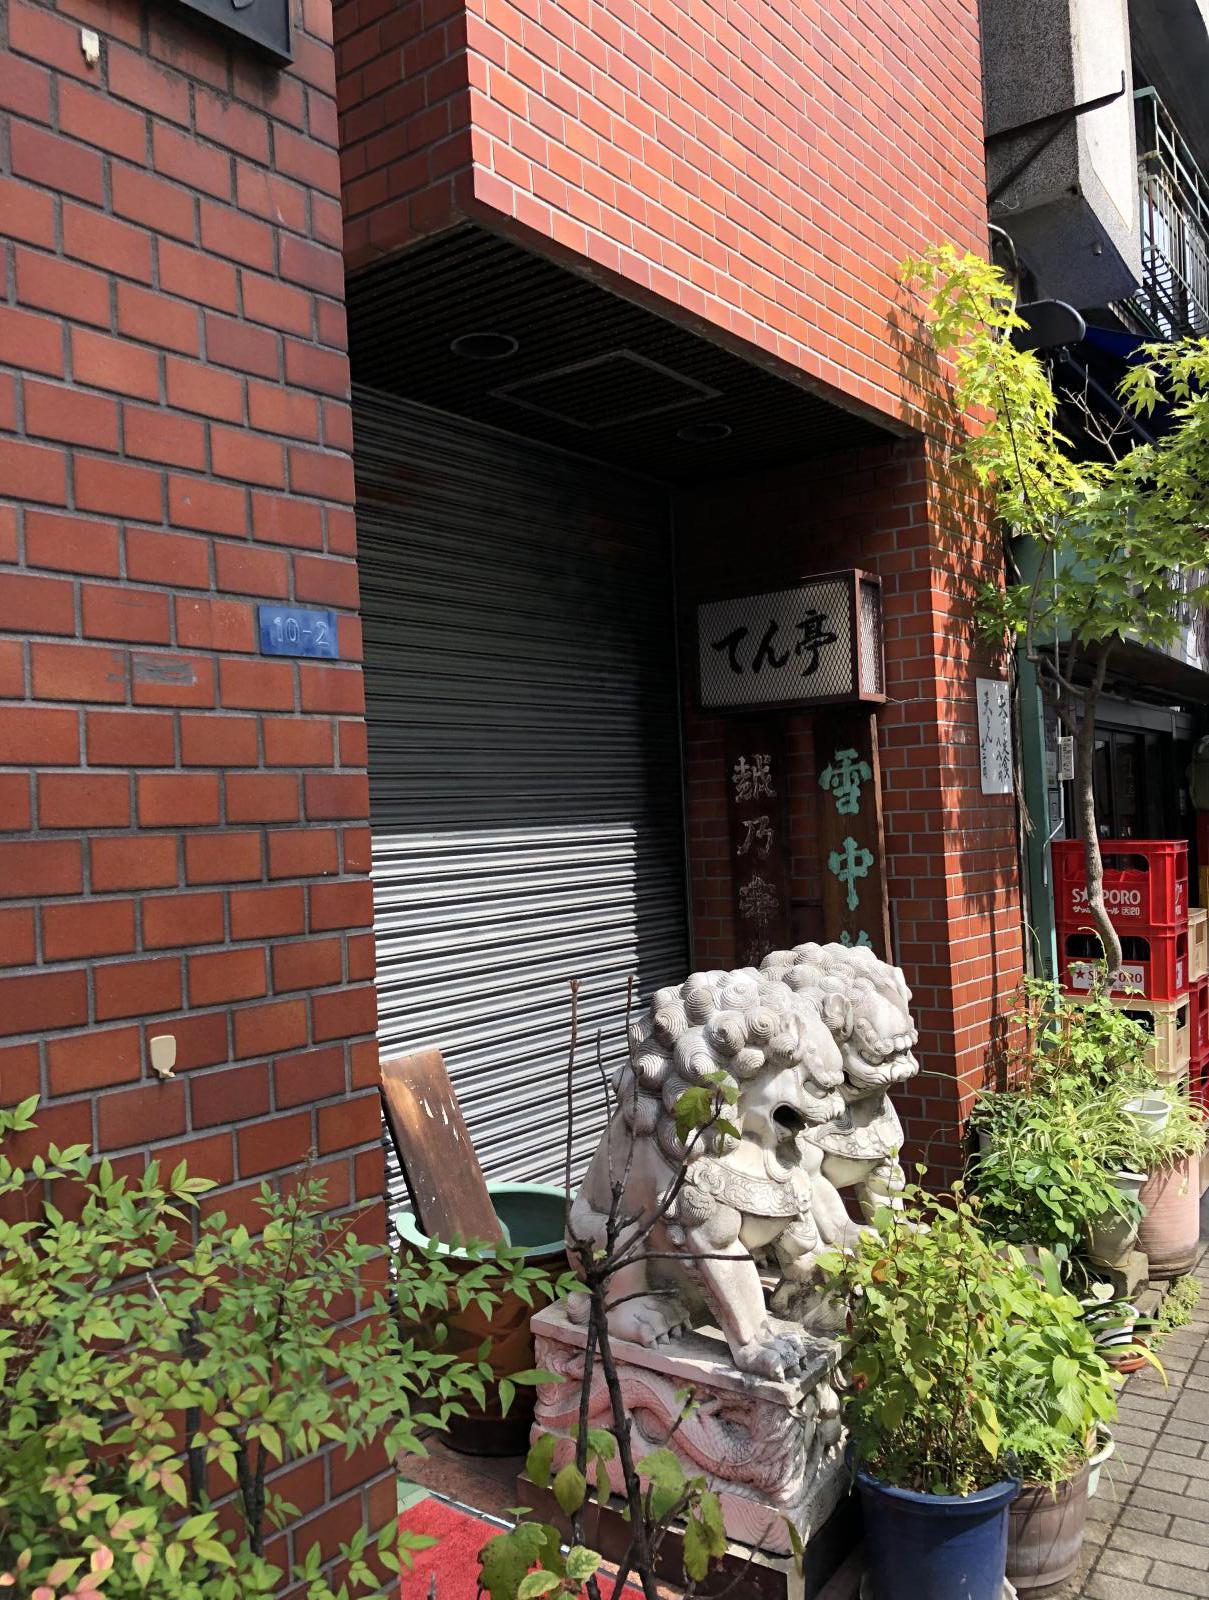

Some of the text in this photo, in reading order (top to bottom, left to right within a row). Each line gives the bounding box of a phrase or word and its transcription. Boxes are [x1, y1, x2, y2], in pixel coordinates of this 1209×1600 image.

[272, 616, 330, 646] 10-2
[711, 608, 838, 677] てん亭
[818, 747, 874, 950] 雪中
[1072, 887, 1141, 905] SAPORO
